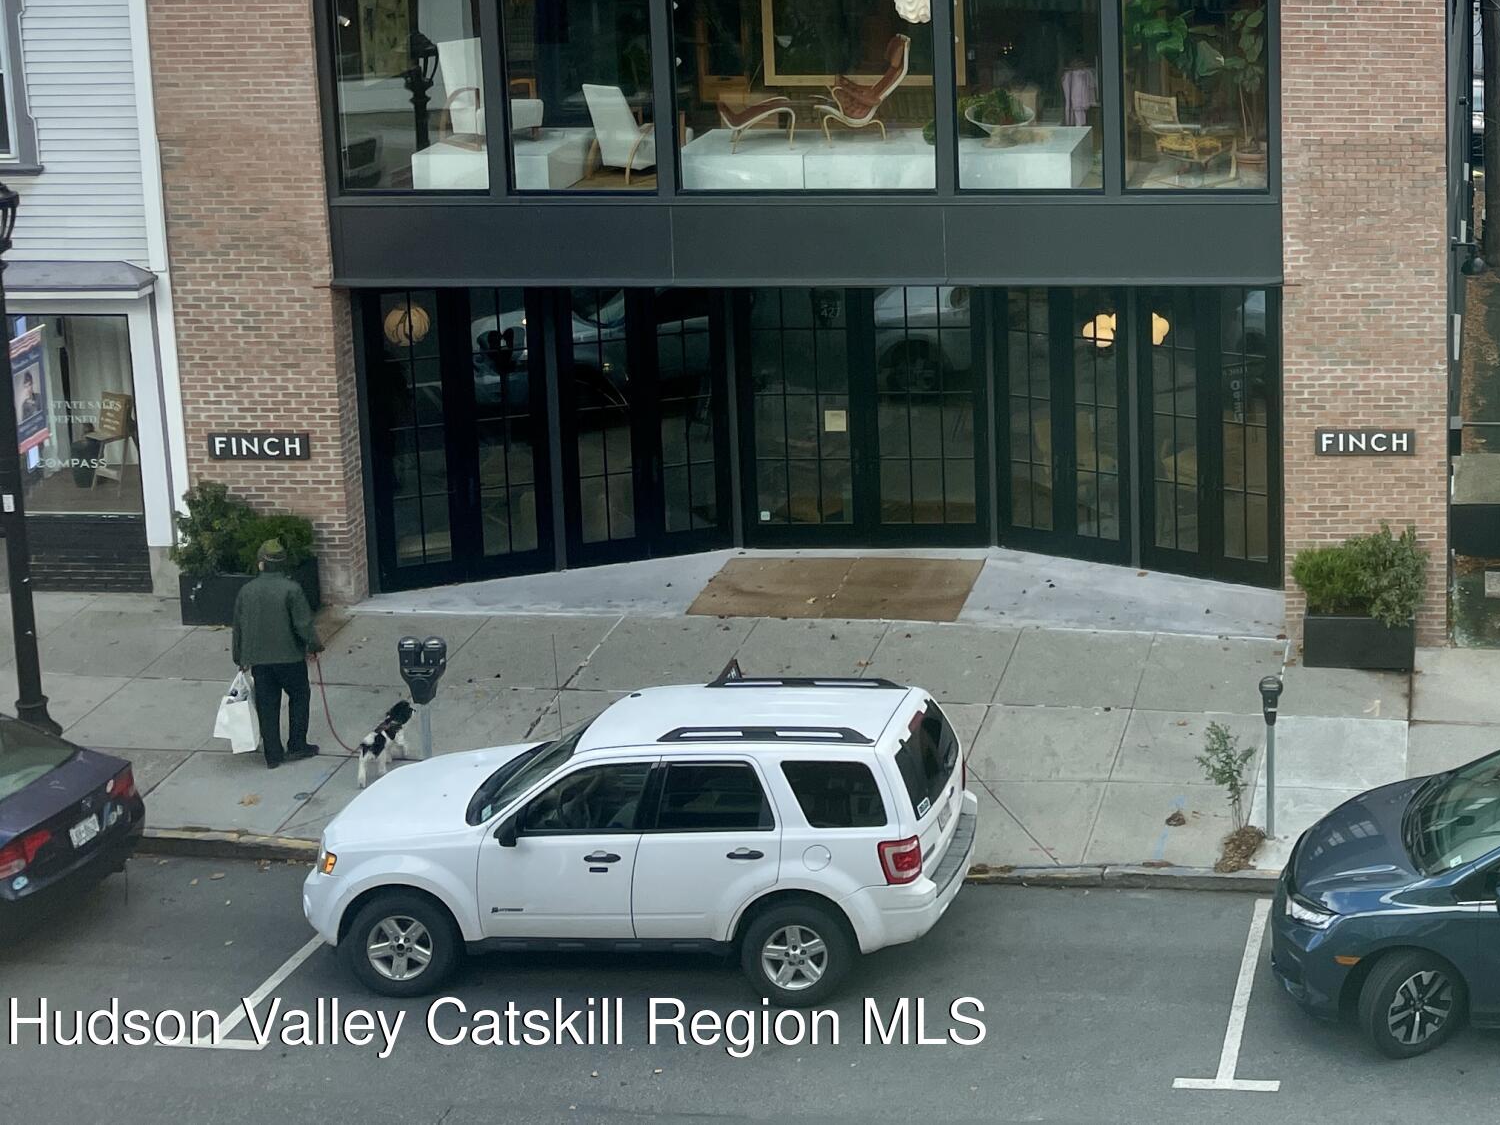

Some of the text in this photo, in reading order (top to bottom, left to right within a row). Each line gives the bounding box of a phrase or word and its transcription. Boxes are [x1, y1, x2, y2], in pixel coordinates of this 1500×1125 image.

[214, 437, 301, 456] FINCH
[1321, 433, 1408, 452] FINCH
[36, 457, 107, 469] COMPASS
